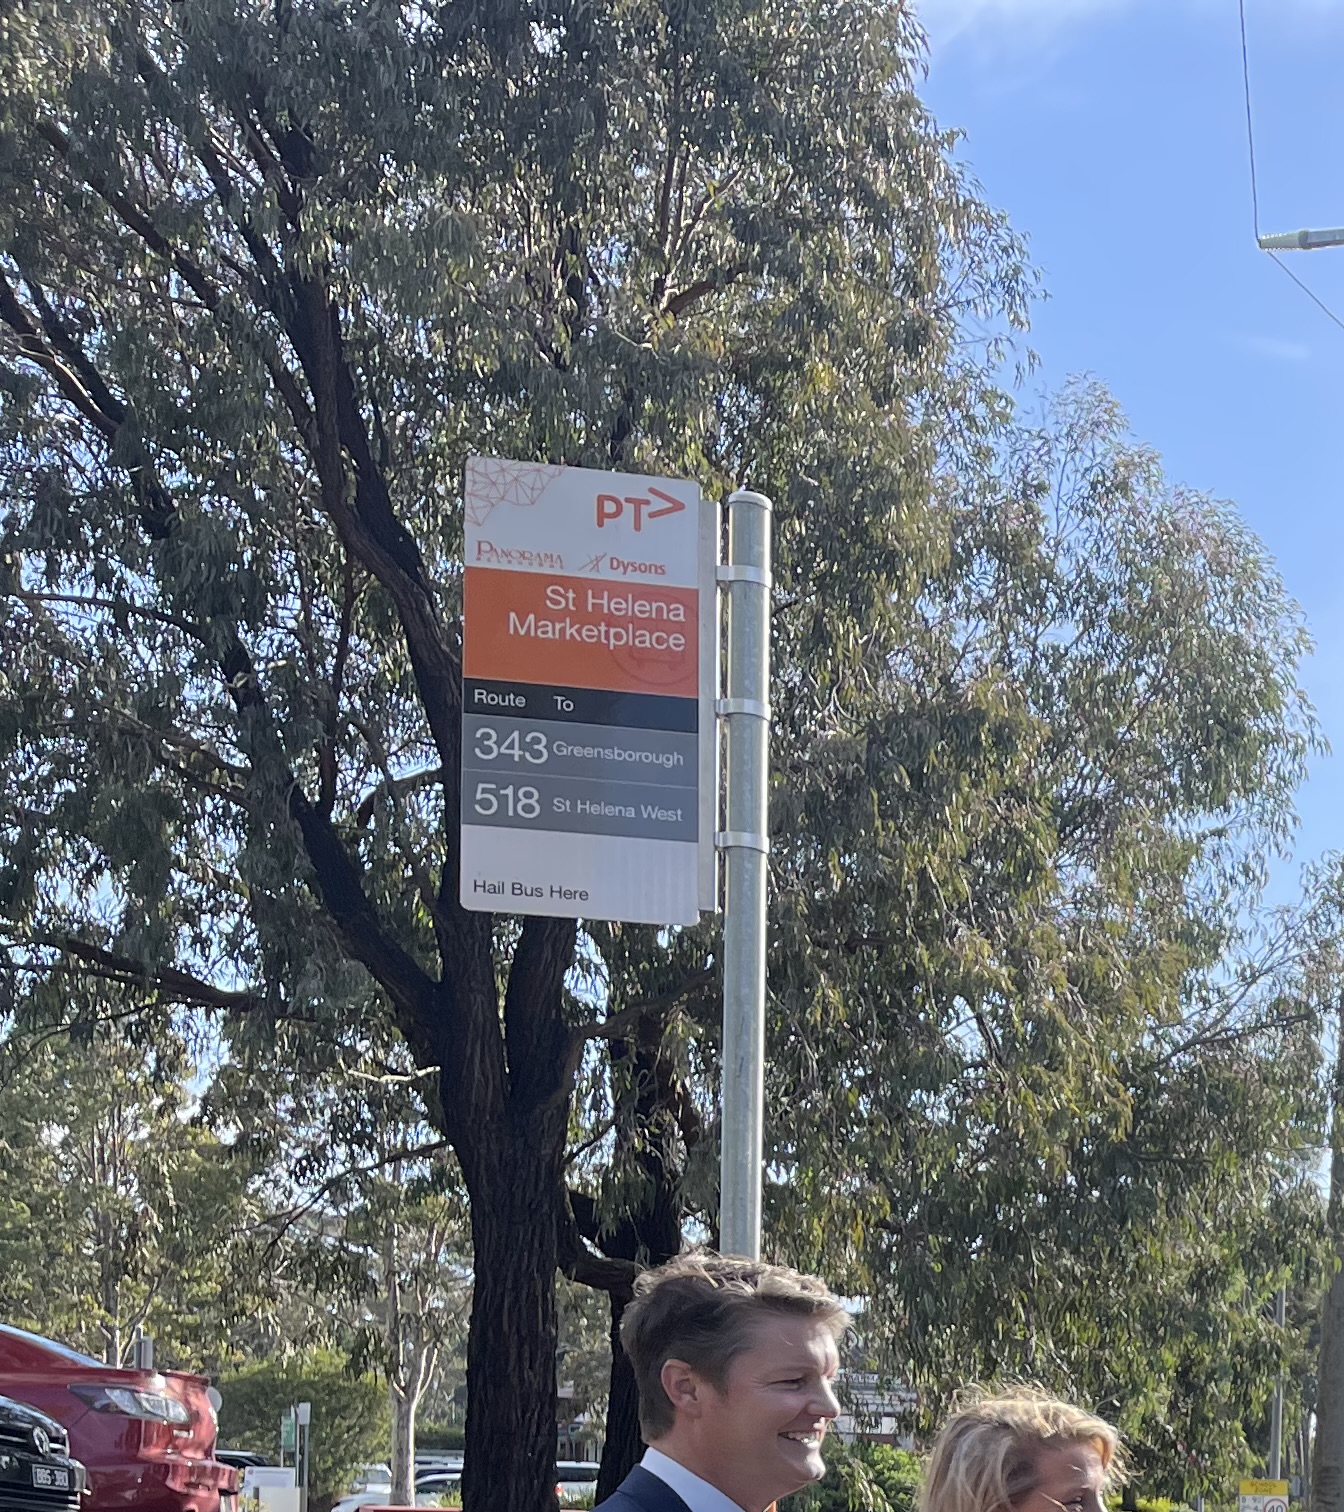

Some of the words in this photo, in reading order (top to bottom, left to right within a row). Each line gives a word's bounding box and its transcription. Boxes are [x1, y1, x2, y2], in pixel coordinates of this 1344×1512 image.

[609, 556, 666, 575] Dysons
[545, 585, 576, 611] St
[587, 589, 686, 622] Helena
[508, 611, 686, 650] Marketplace
[474, 689, 526, 707] Route
[553, 695, 574, 711] To
[474, 727, 548, 764] 343
[552, 740, 684, 768] Greensborough
[474, 782, 541, 819] 518
[552, 797, 571, 813] St
[577, 799, 636, 819] Helena
[640, 804, 683, 822] West
[473, 879, 505, 895] Hail
[511, 881, 544, 898] Bus
[550, 885, 589, 901] Here
